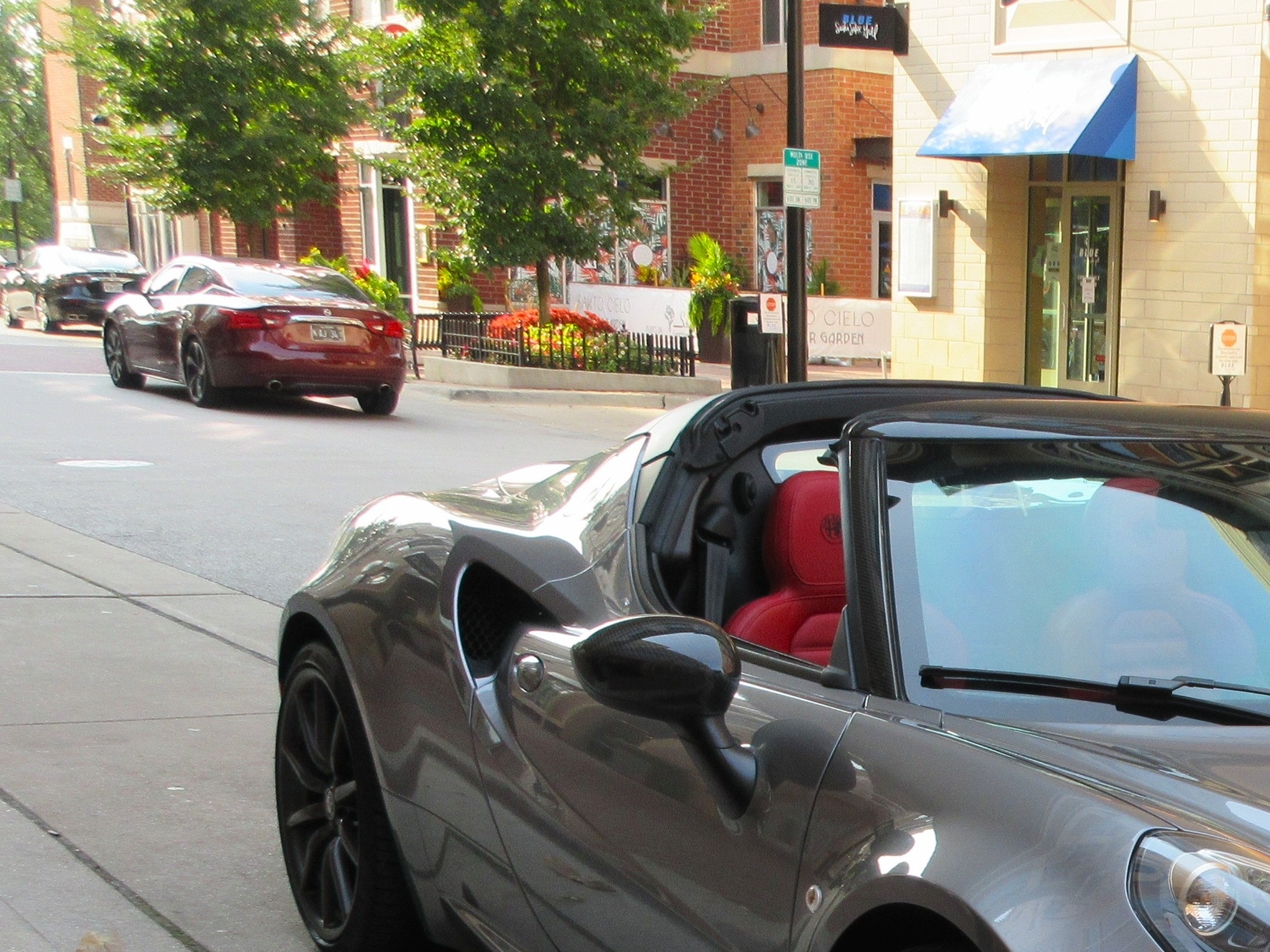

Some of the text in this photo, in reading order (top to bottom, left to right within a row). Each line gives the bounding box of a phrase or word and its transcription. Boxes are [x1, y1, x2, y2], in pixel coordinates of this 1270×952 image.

[842, 14, 873, 25] BLUE
[1079, 248, 1100, 258] BLUE
[823, 310, 875, 328] CIELO
[820, 332, 864, 345] GARDEN
